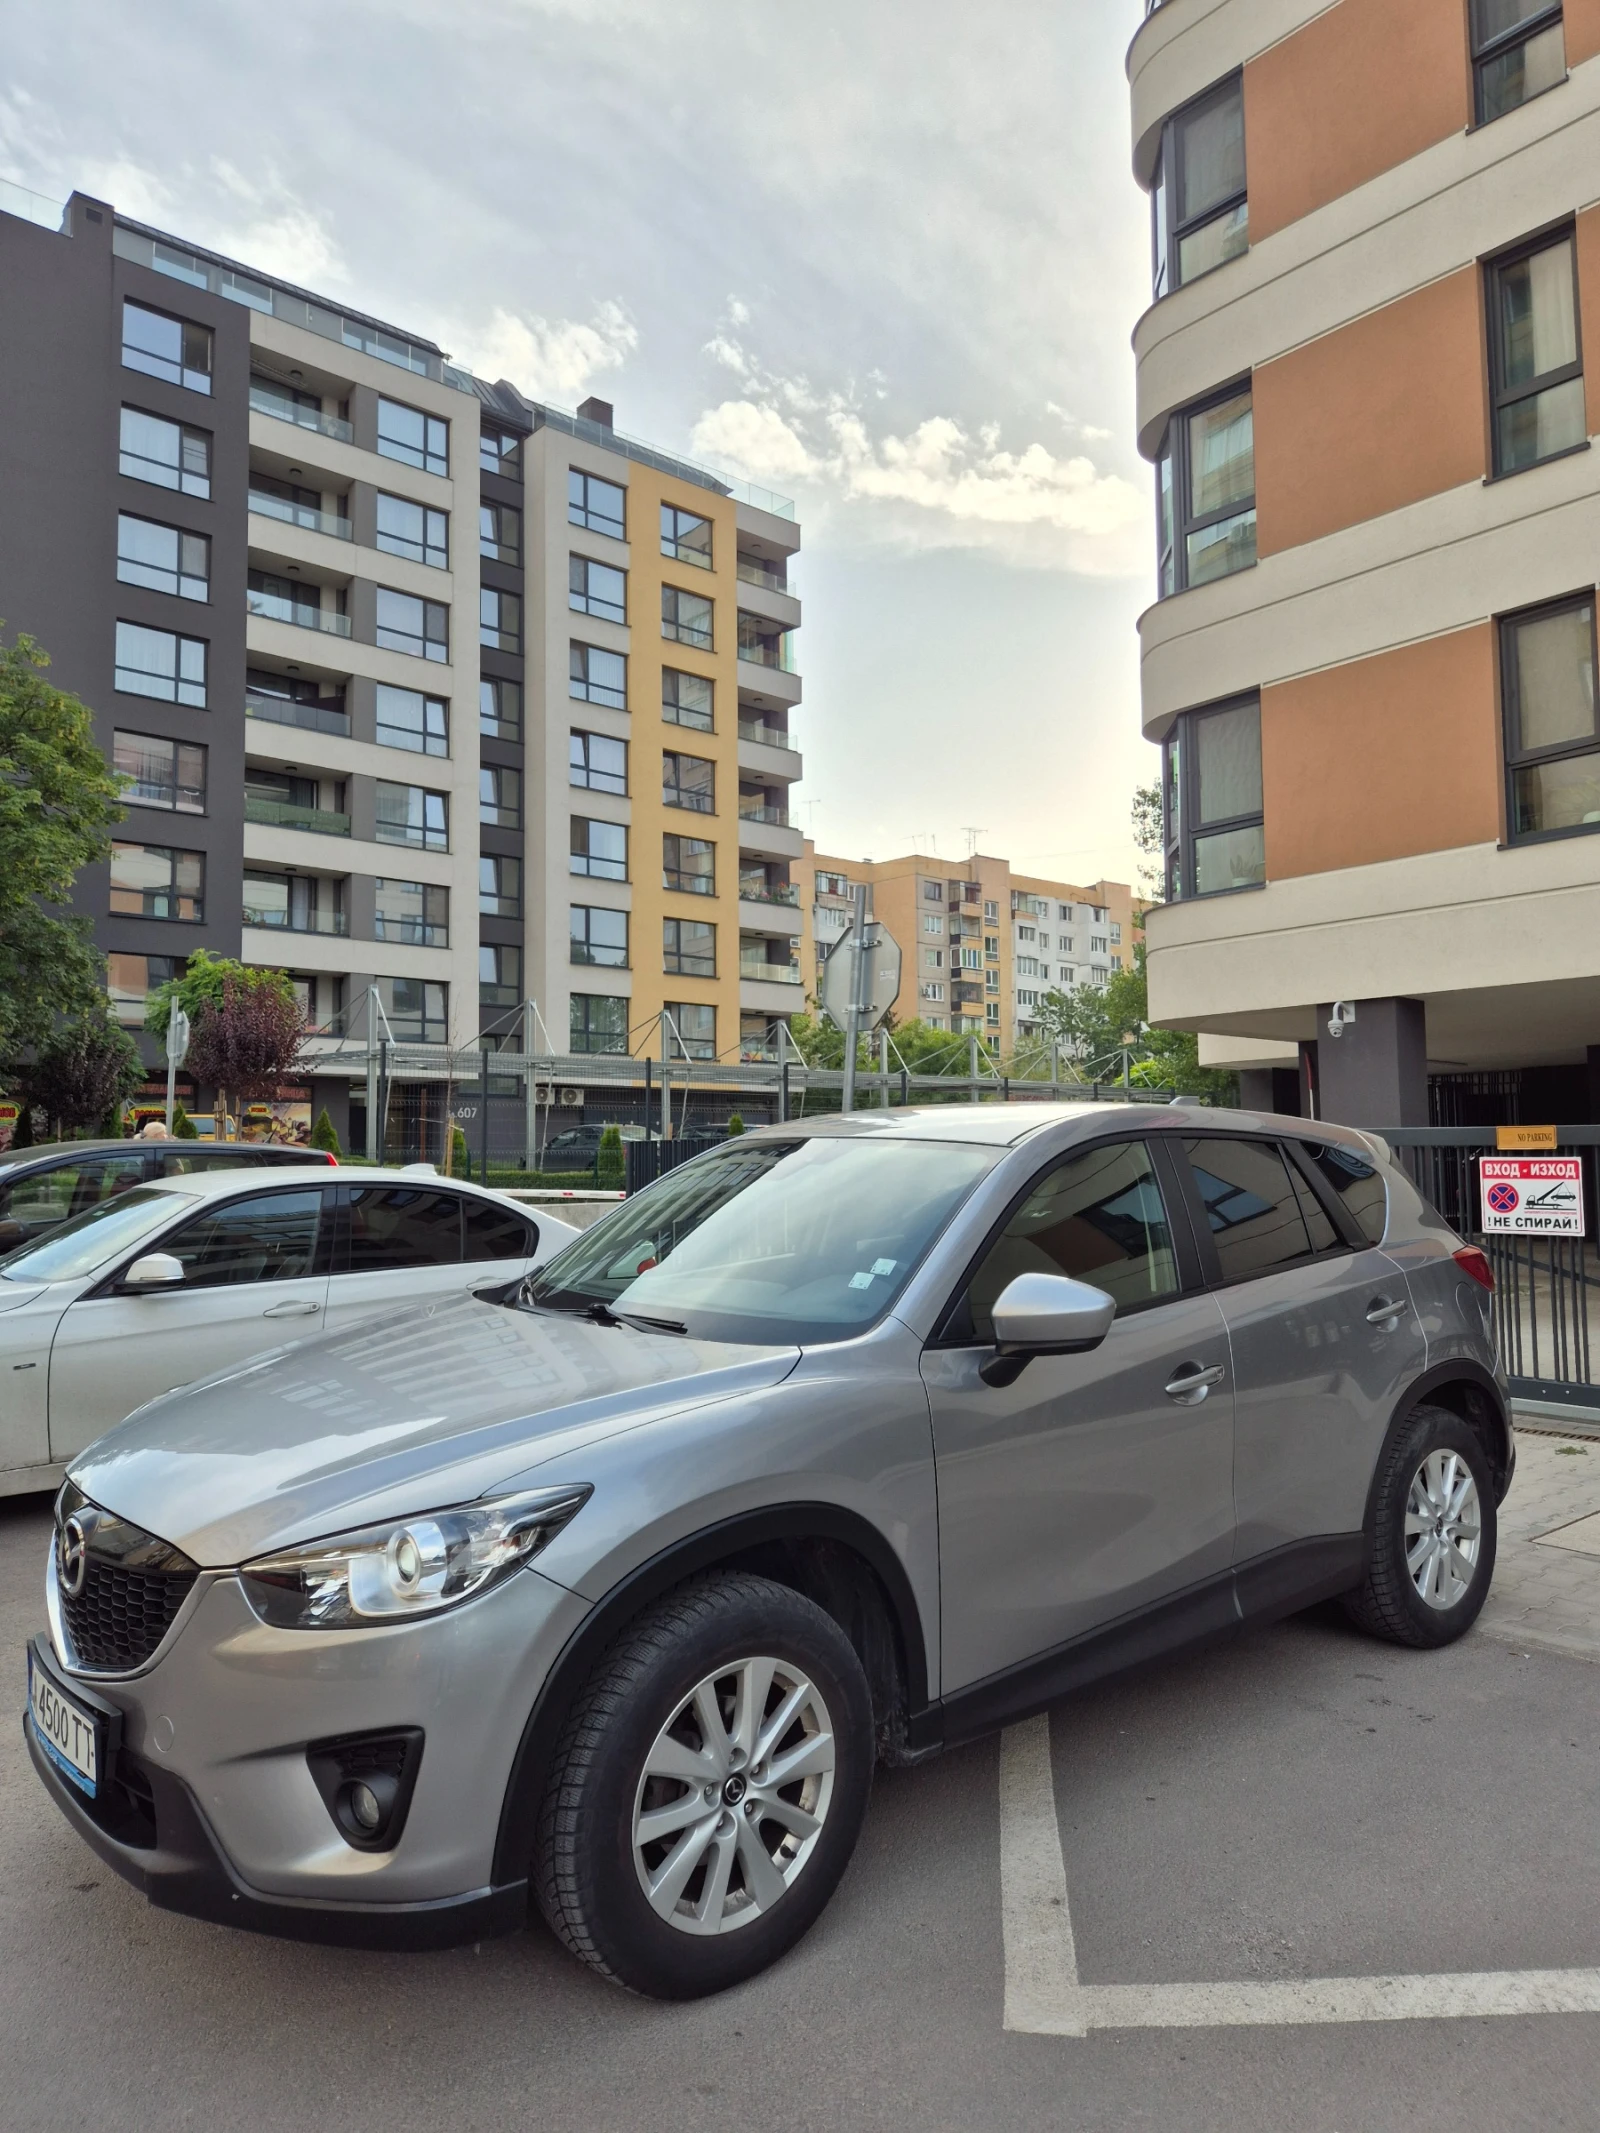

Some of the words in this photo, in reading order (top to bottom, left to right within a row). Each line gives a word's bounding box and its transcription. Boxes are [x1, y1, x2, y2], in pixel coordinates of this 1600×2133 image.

[1517, 1133, 1527, 1142] NO
[1527, 1133, 1552, 1142] PARKING
[1485, 1163, 1520, 1178] ВХОД
[1530, 1163, 1576, 1179] ИЗХОД
[39, 1683, 69, 1749] 4500
[72, 1713, 93, 1770] TT
